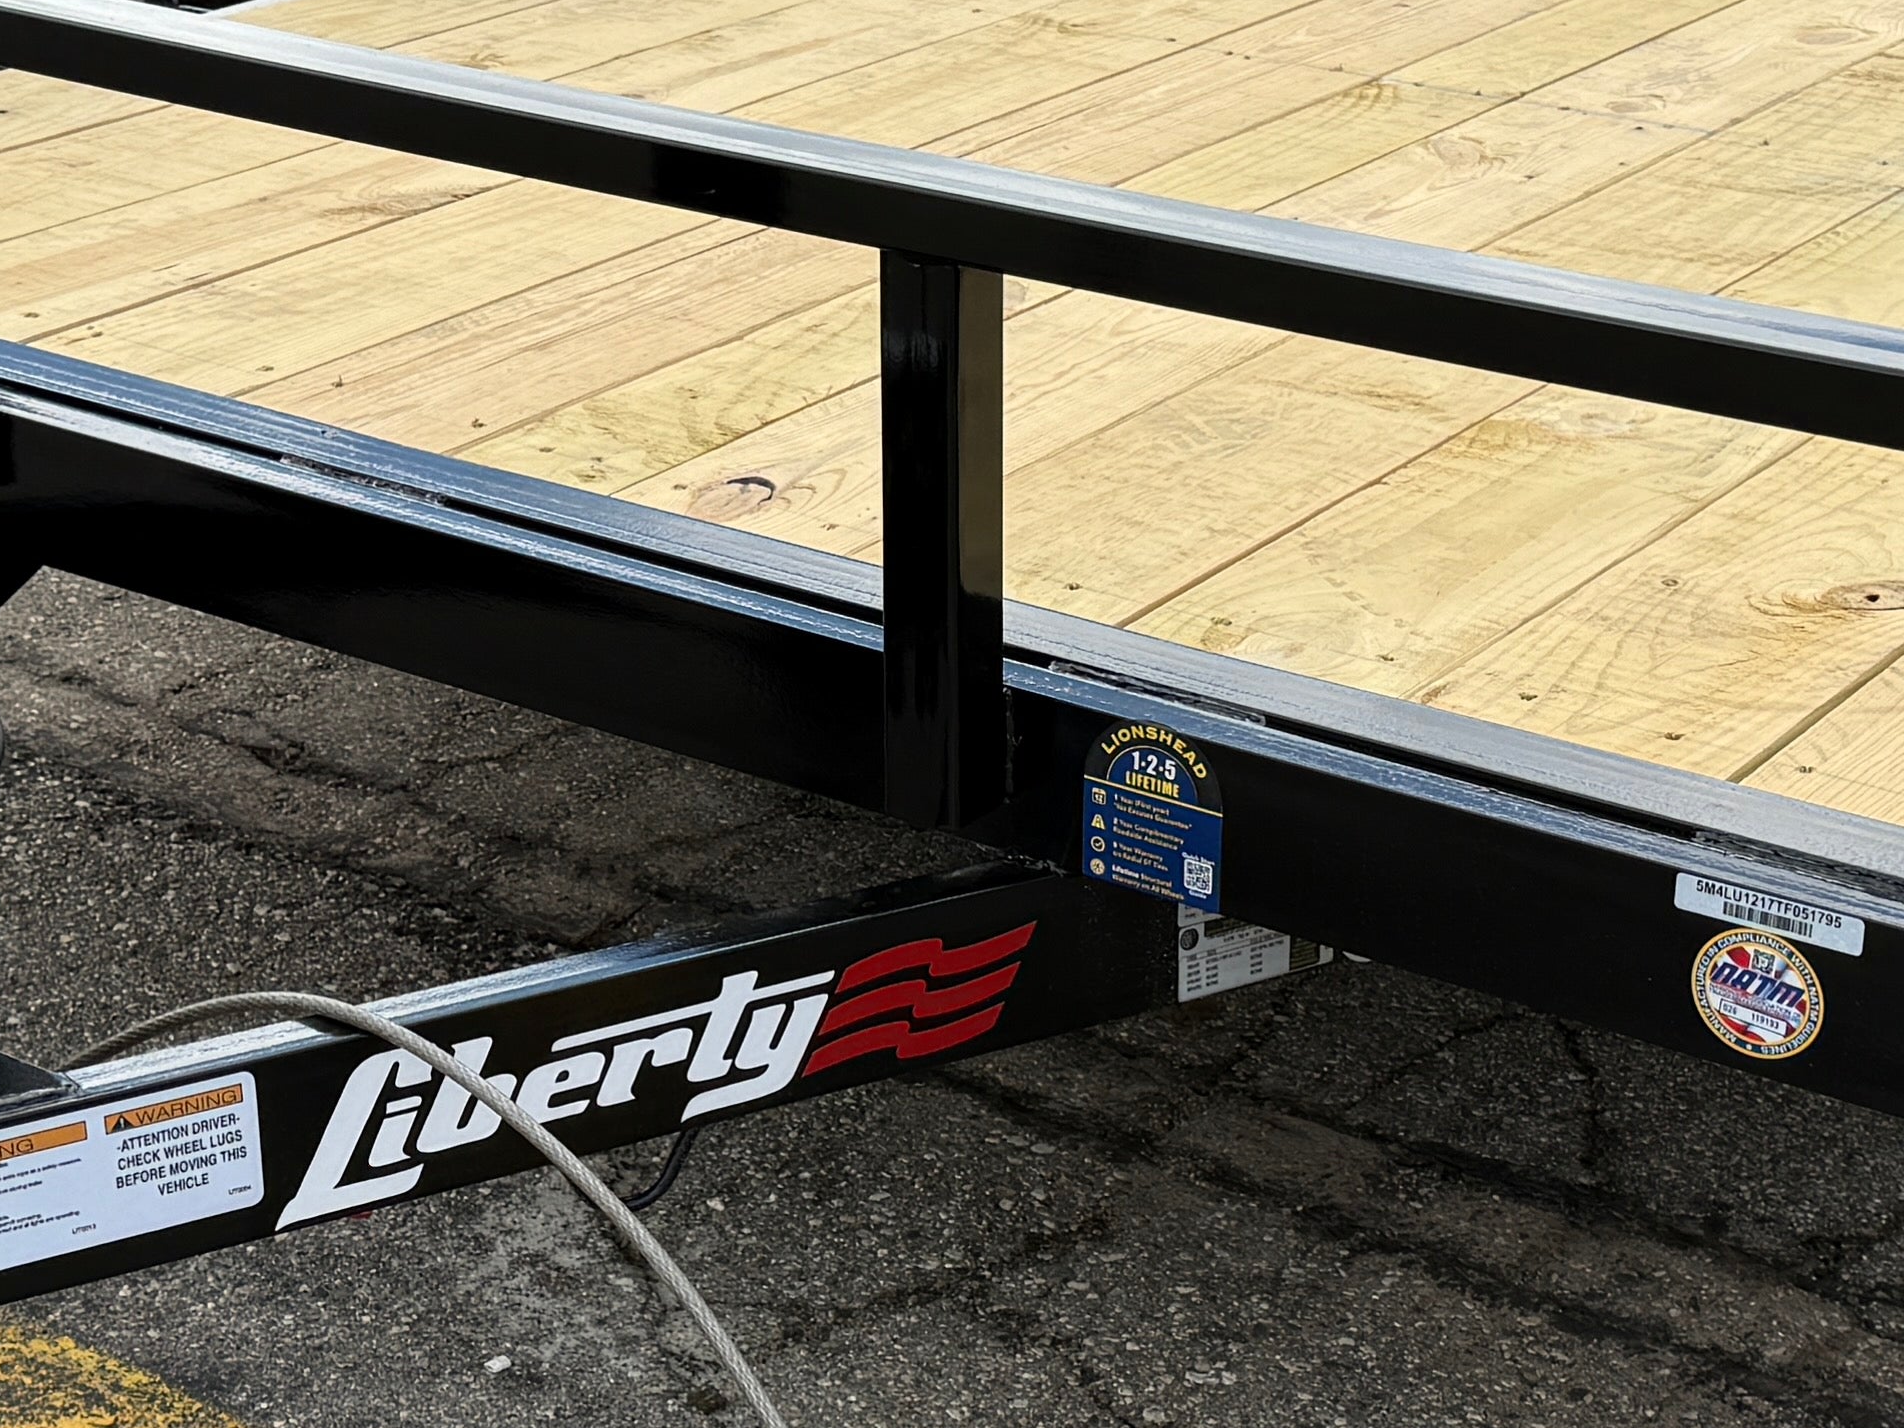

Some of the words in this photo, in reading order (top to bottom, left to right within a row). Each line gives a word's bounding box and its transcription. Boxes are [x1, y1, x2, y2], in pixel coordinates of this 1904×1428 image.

[1101, 725, 1207, 778] LIONSHEAD
[1126, 771, 1179, 798] LIFETIME
[1696, 879, 1842, 929] 5M4LU1217TF051795
[1718, 933, 1792, 955] COMPLIANCE
[1791, 955, 1813, 984] WITH
[1809, 987, 1819, 1022] NATM
[136, 1090, 236, 1124] WARNING
[275, 970, 836, 1232] Liberty
[116, 1166, 166, 1189] BEFORE
[170, 1155, 217, 1176] MOVING
[221, 1146, 247, 1163] THIS
[118, 1150, 161, 1171] CHECK
[164, 1138, 207, 1159] WHEEL
[210, 1130, 243, 1147] LUGS
[158, 1173, 209, 1196] VEHICLE
